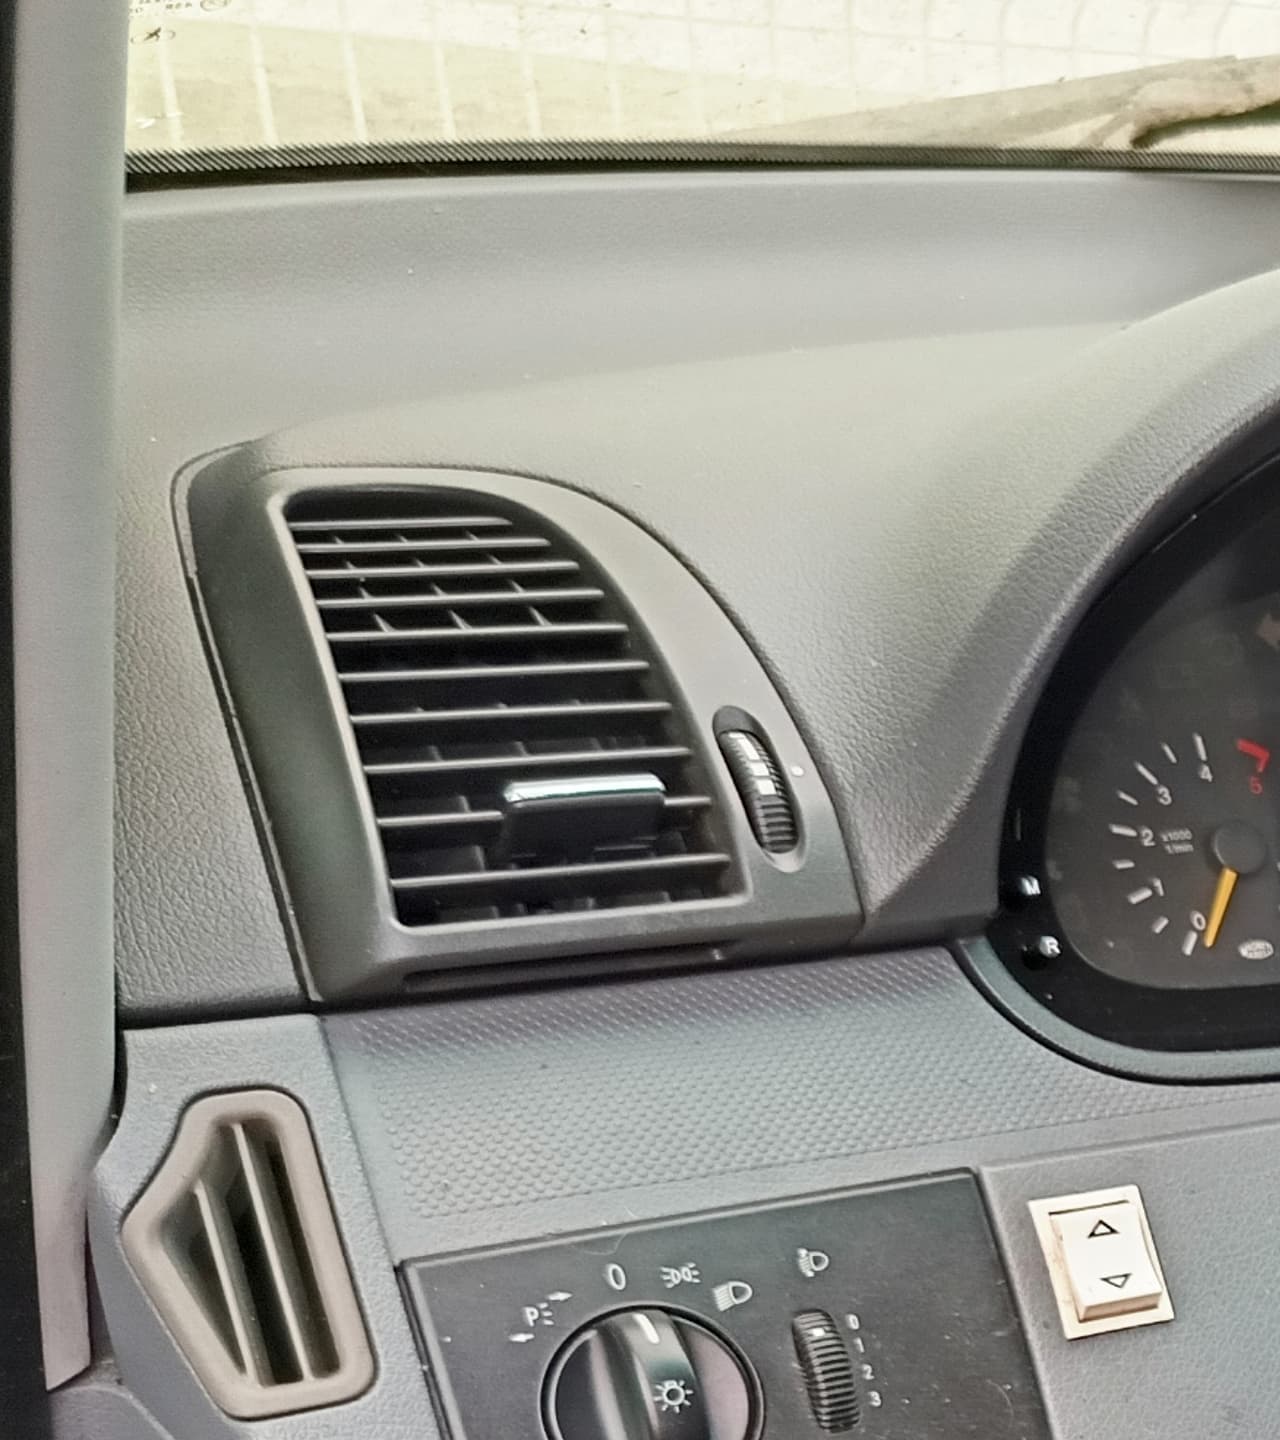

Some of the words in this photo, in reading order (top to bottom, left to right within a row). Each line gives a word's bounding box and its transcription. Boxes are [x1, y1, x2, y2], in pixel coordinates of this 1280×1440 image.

[1200, 764, 1213, 782] 4
[1251, 777, 1263, 795] 5
[1157, 786, 1172, 805] 3
[1140, 827, 1155, 847] 2
[1022, 876, 1041, 896] M
[1152, 877, 1164, 896] 1
[1191, 910, 1206, 931] 0
[846, 1314, 860, 1330] 0
[854, 1337, 865, 1352] 1
[861, 1363, 875, 1380] 2
[868, 1390, 882, 1408] 3
